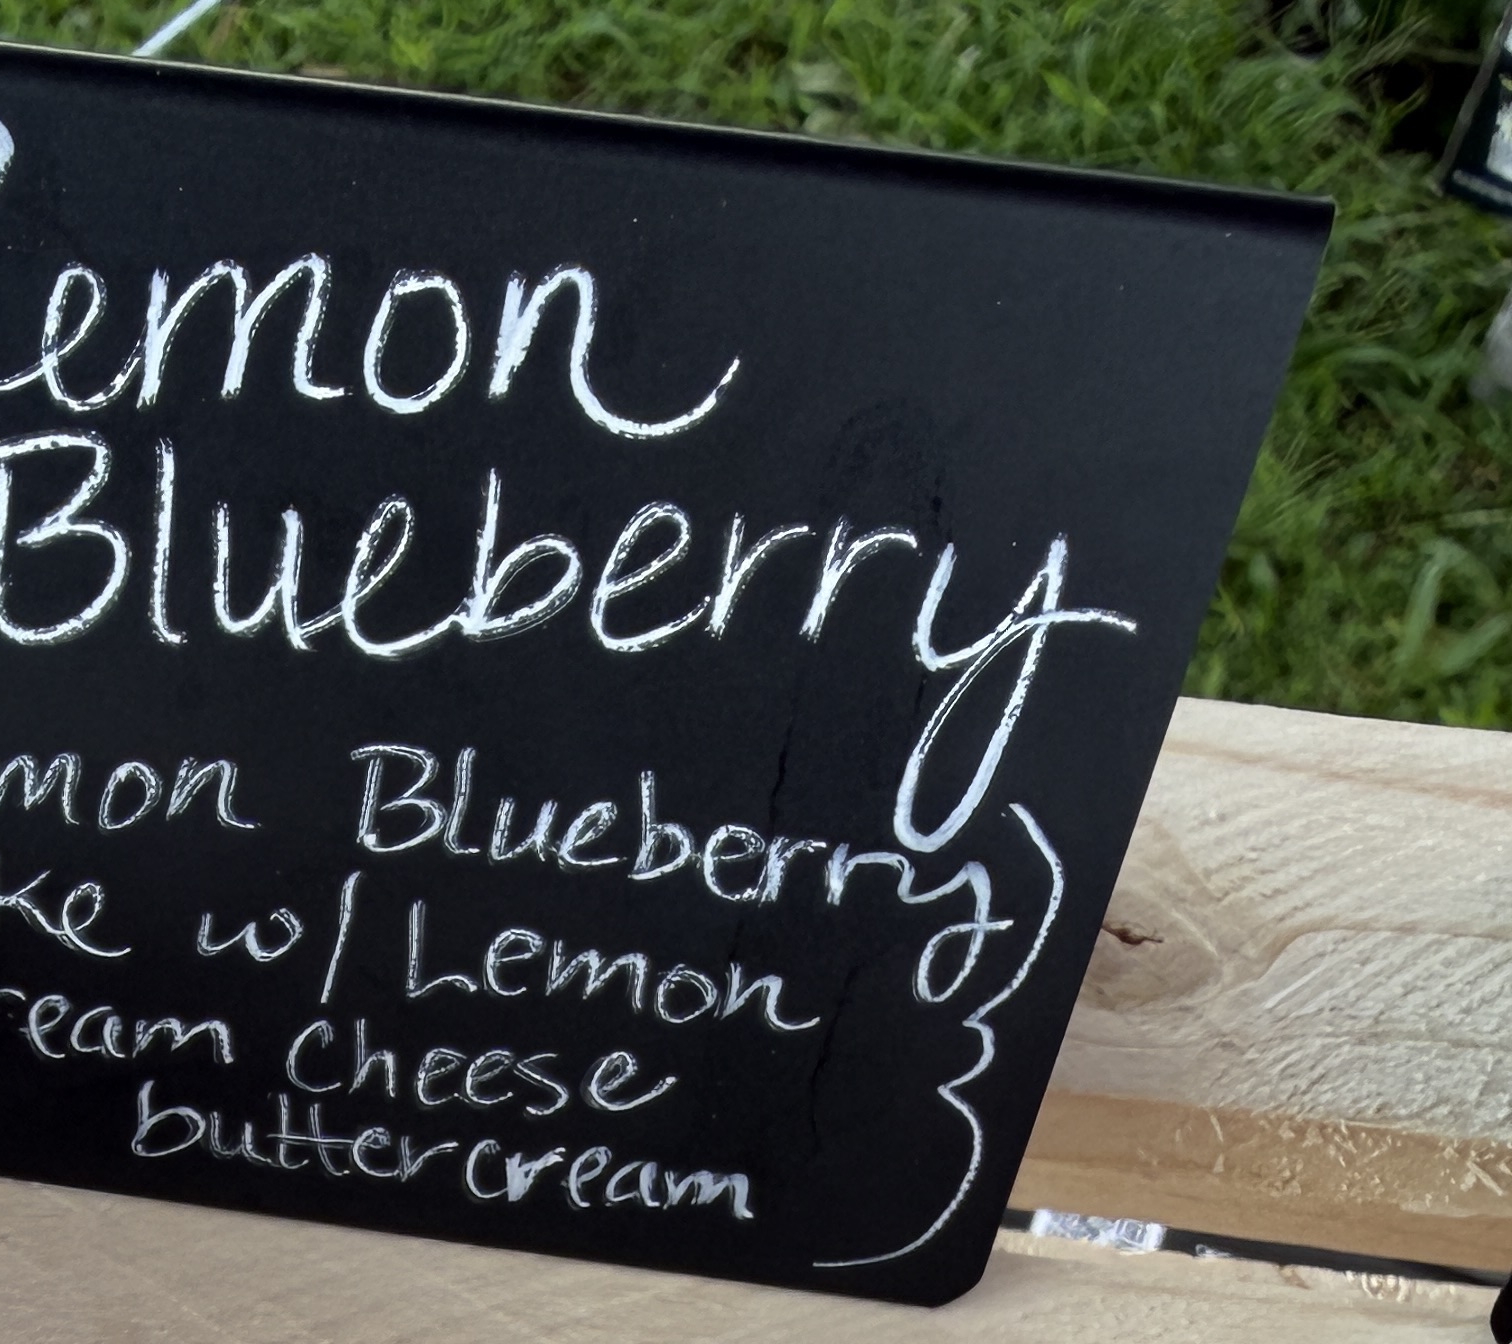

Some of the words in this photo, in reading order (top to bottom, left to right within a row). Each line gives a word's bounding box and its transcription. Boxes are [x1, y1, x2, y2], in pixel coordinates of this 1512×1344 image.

[197, 870, 360, 1005] w/
[406, 898, 822, 1033] Lemon
[349, 743, 1015, 1003] Blueberry
